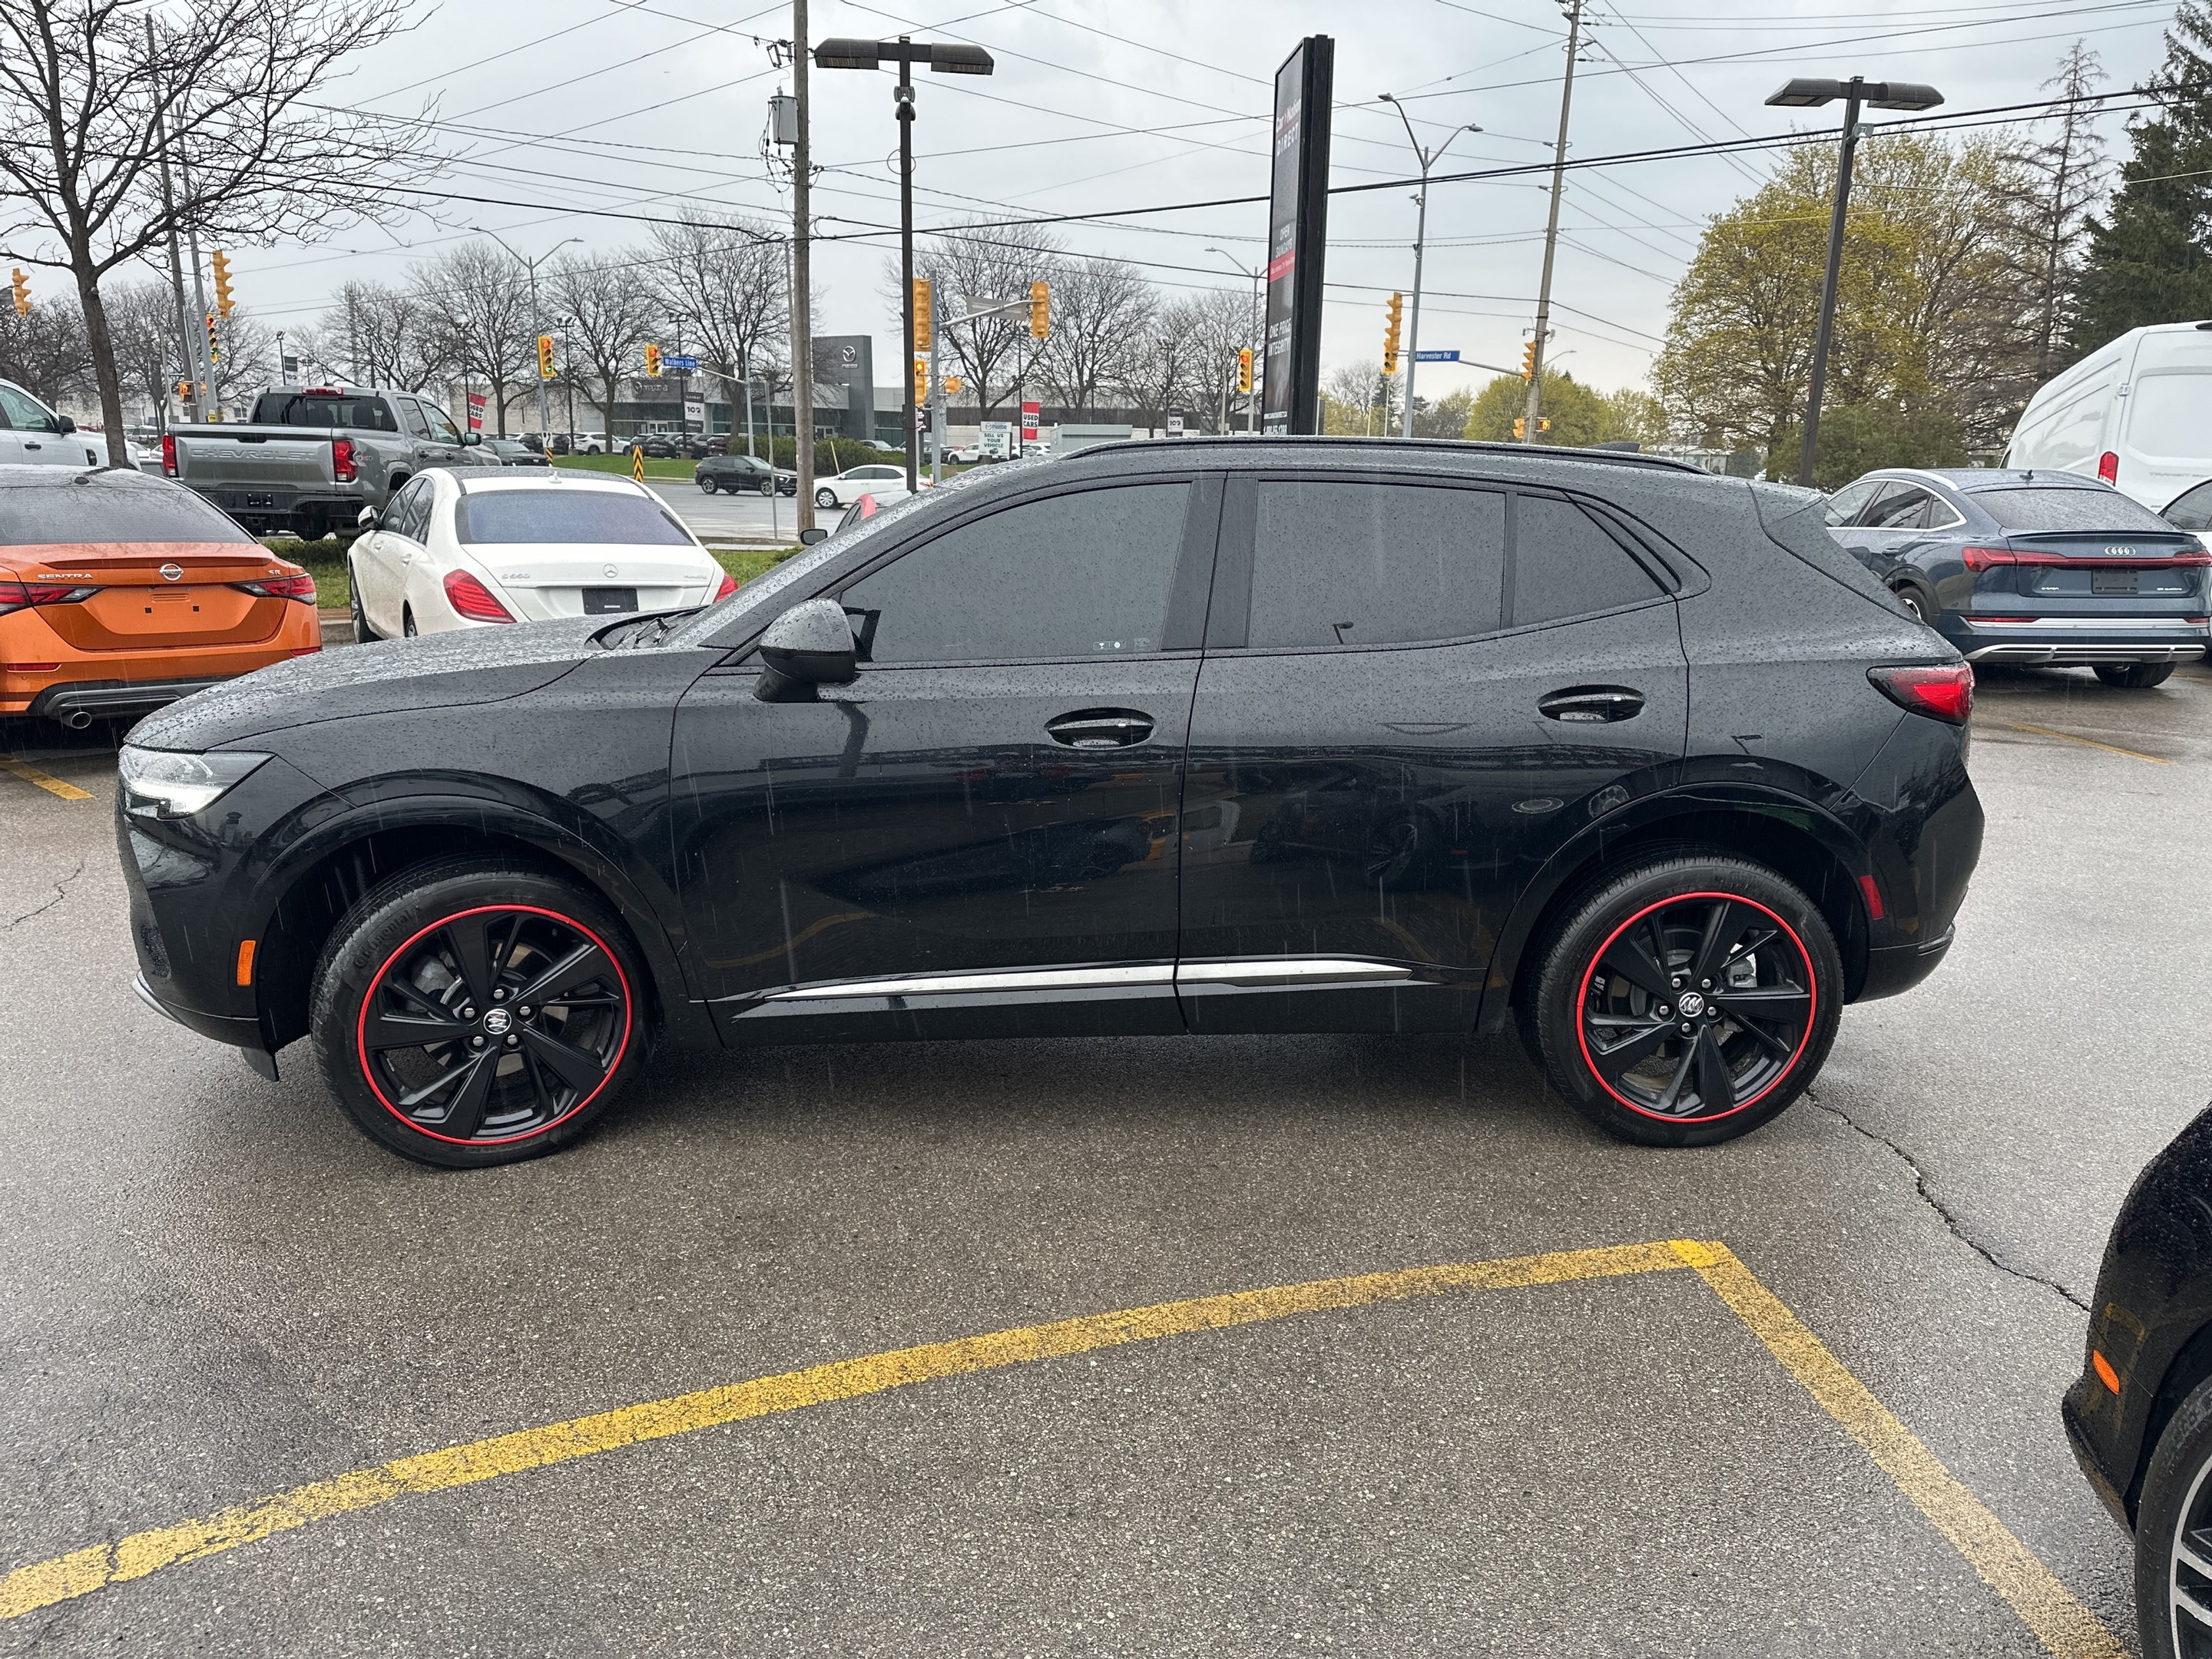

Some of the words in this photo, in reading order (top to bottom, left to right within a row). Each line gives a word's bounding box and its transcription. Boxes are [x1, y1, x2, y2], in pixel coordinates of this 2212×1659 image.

[1277, 122, 1299, 157] DIRECT
[664, 358, 684, 366] Walkers
[190, 449, 315, 460] CHEVROLET
